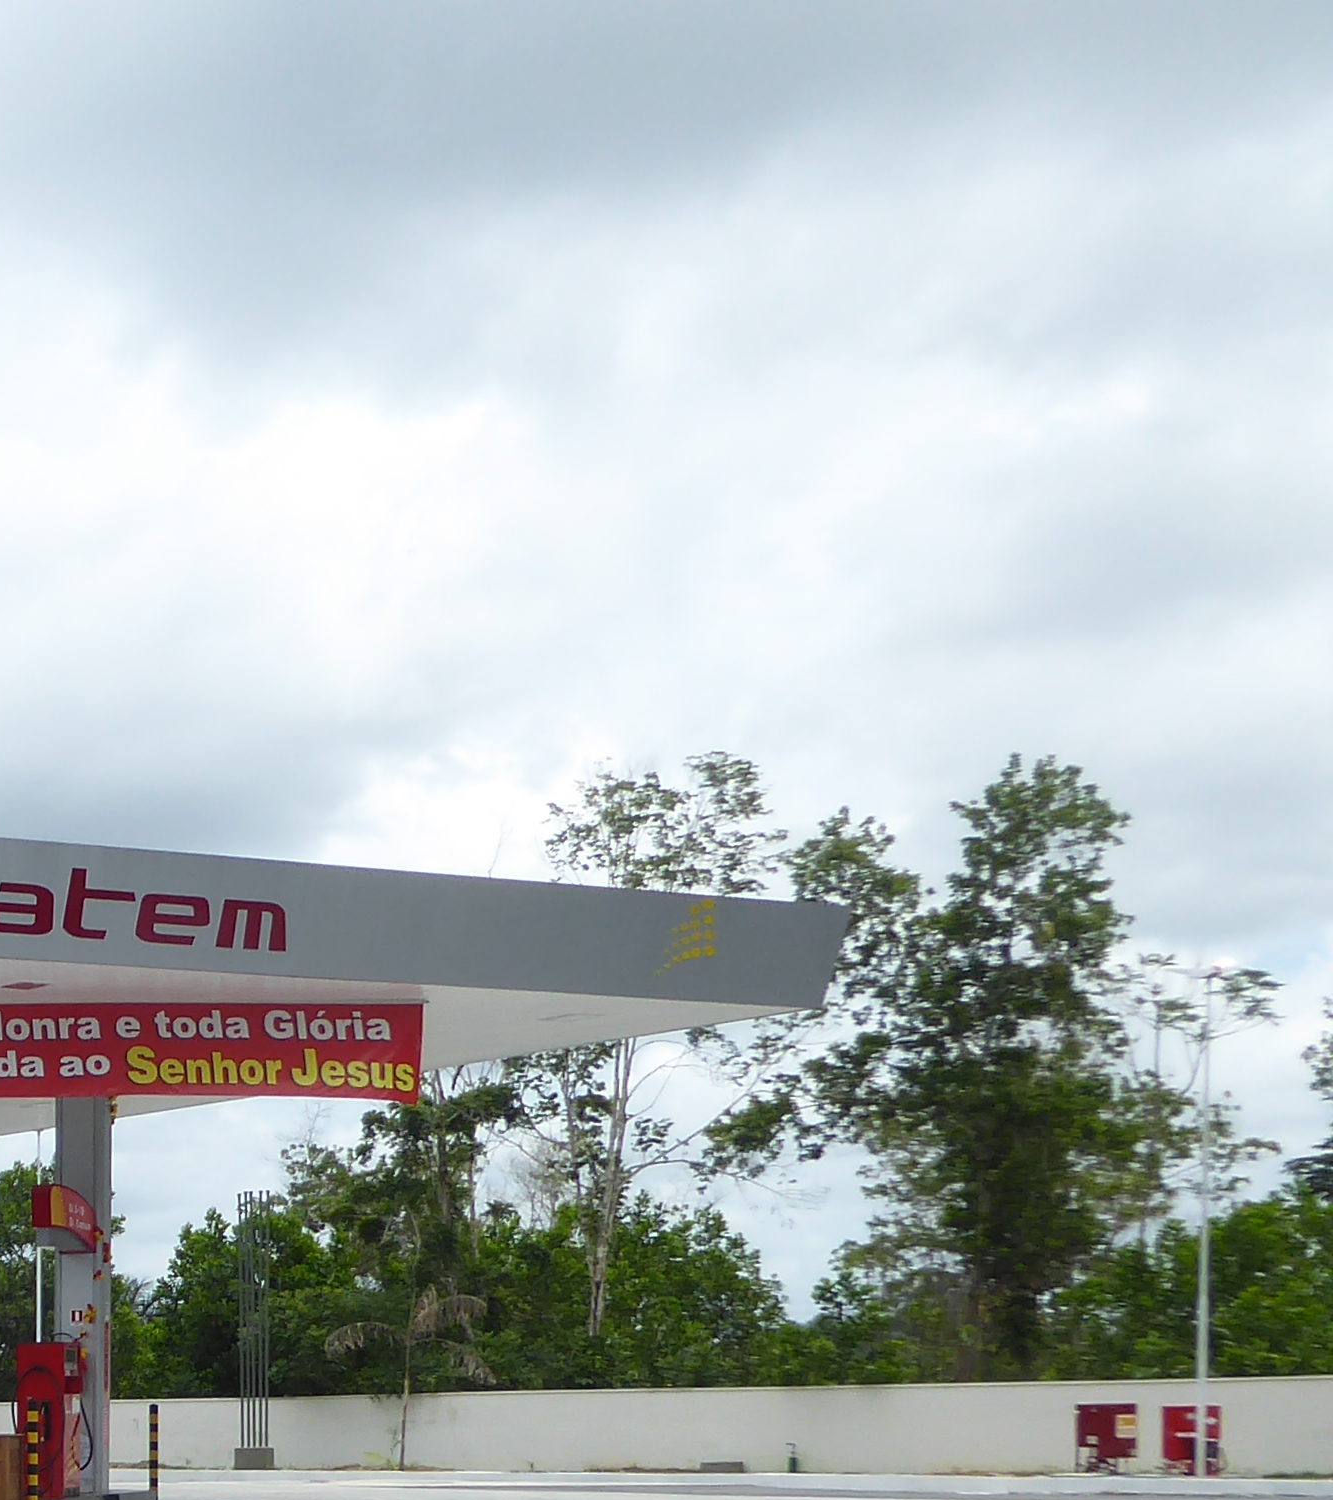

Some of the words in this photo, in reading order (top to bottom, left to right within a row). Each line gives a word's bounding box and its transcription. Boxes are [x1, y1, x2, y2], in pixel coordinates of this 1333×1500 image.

[115, 1016, 141, 1038] e
[154, 1009, 250, 1039] toda
[263, 1010, 392, 1041] Glória
[59, 1054, 111, 1078] ao
[126, 1046, 282, 1085] Senhor
[291, 1048, 414, 1092] Jesus
